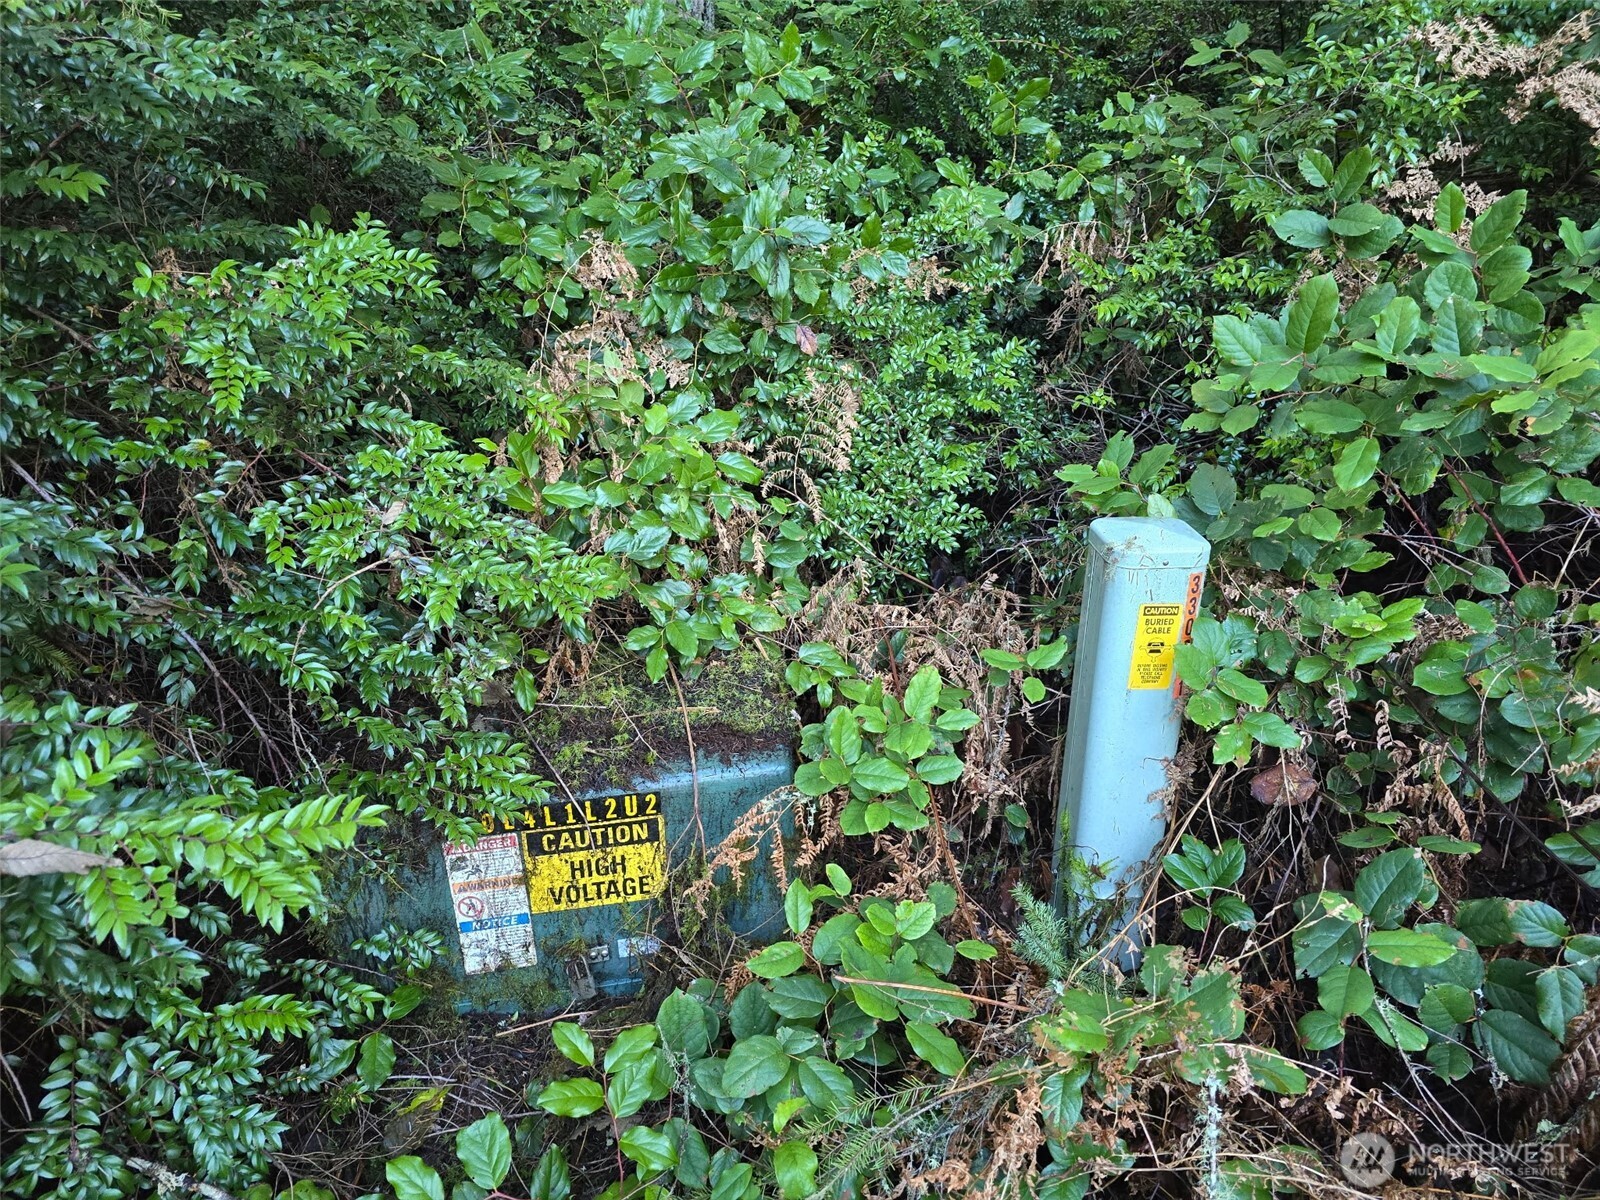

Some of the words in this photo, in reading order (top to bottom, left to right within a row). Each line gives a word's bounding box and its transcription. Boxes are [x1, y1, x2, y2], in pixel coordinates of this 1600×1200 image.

[1144, 607, 1179, 615] CAUTION
[541, 822, 649, 852] CAUTION
[568, 854, 627, 880] HIGH
[549, 876, 652, 906] VOLTAGE
[472, 915, 519, 931] NOTICE
